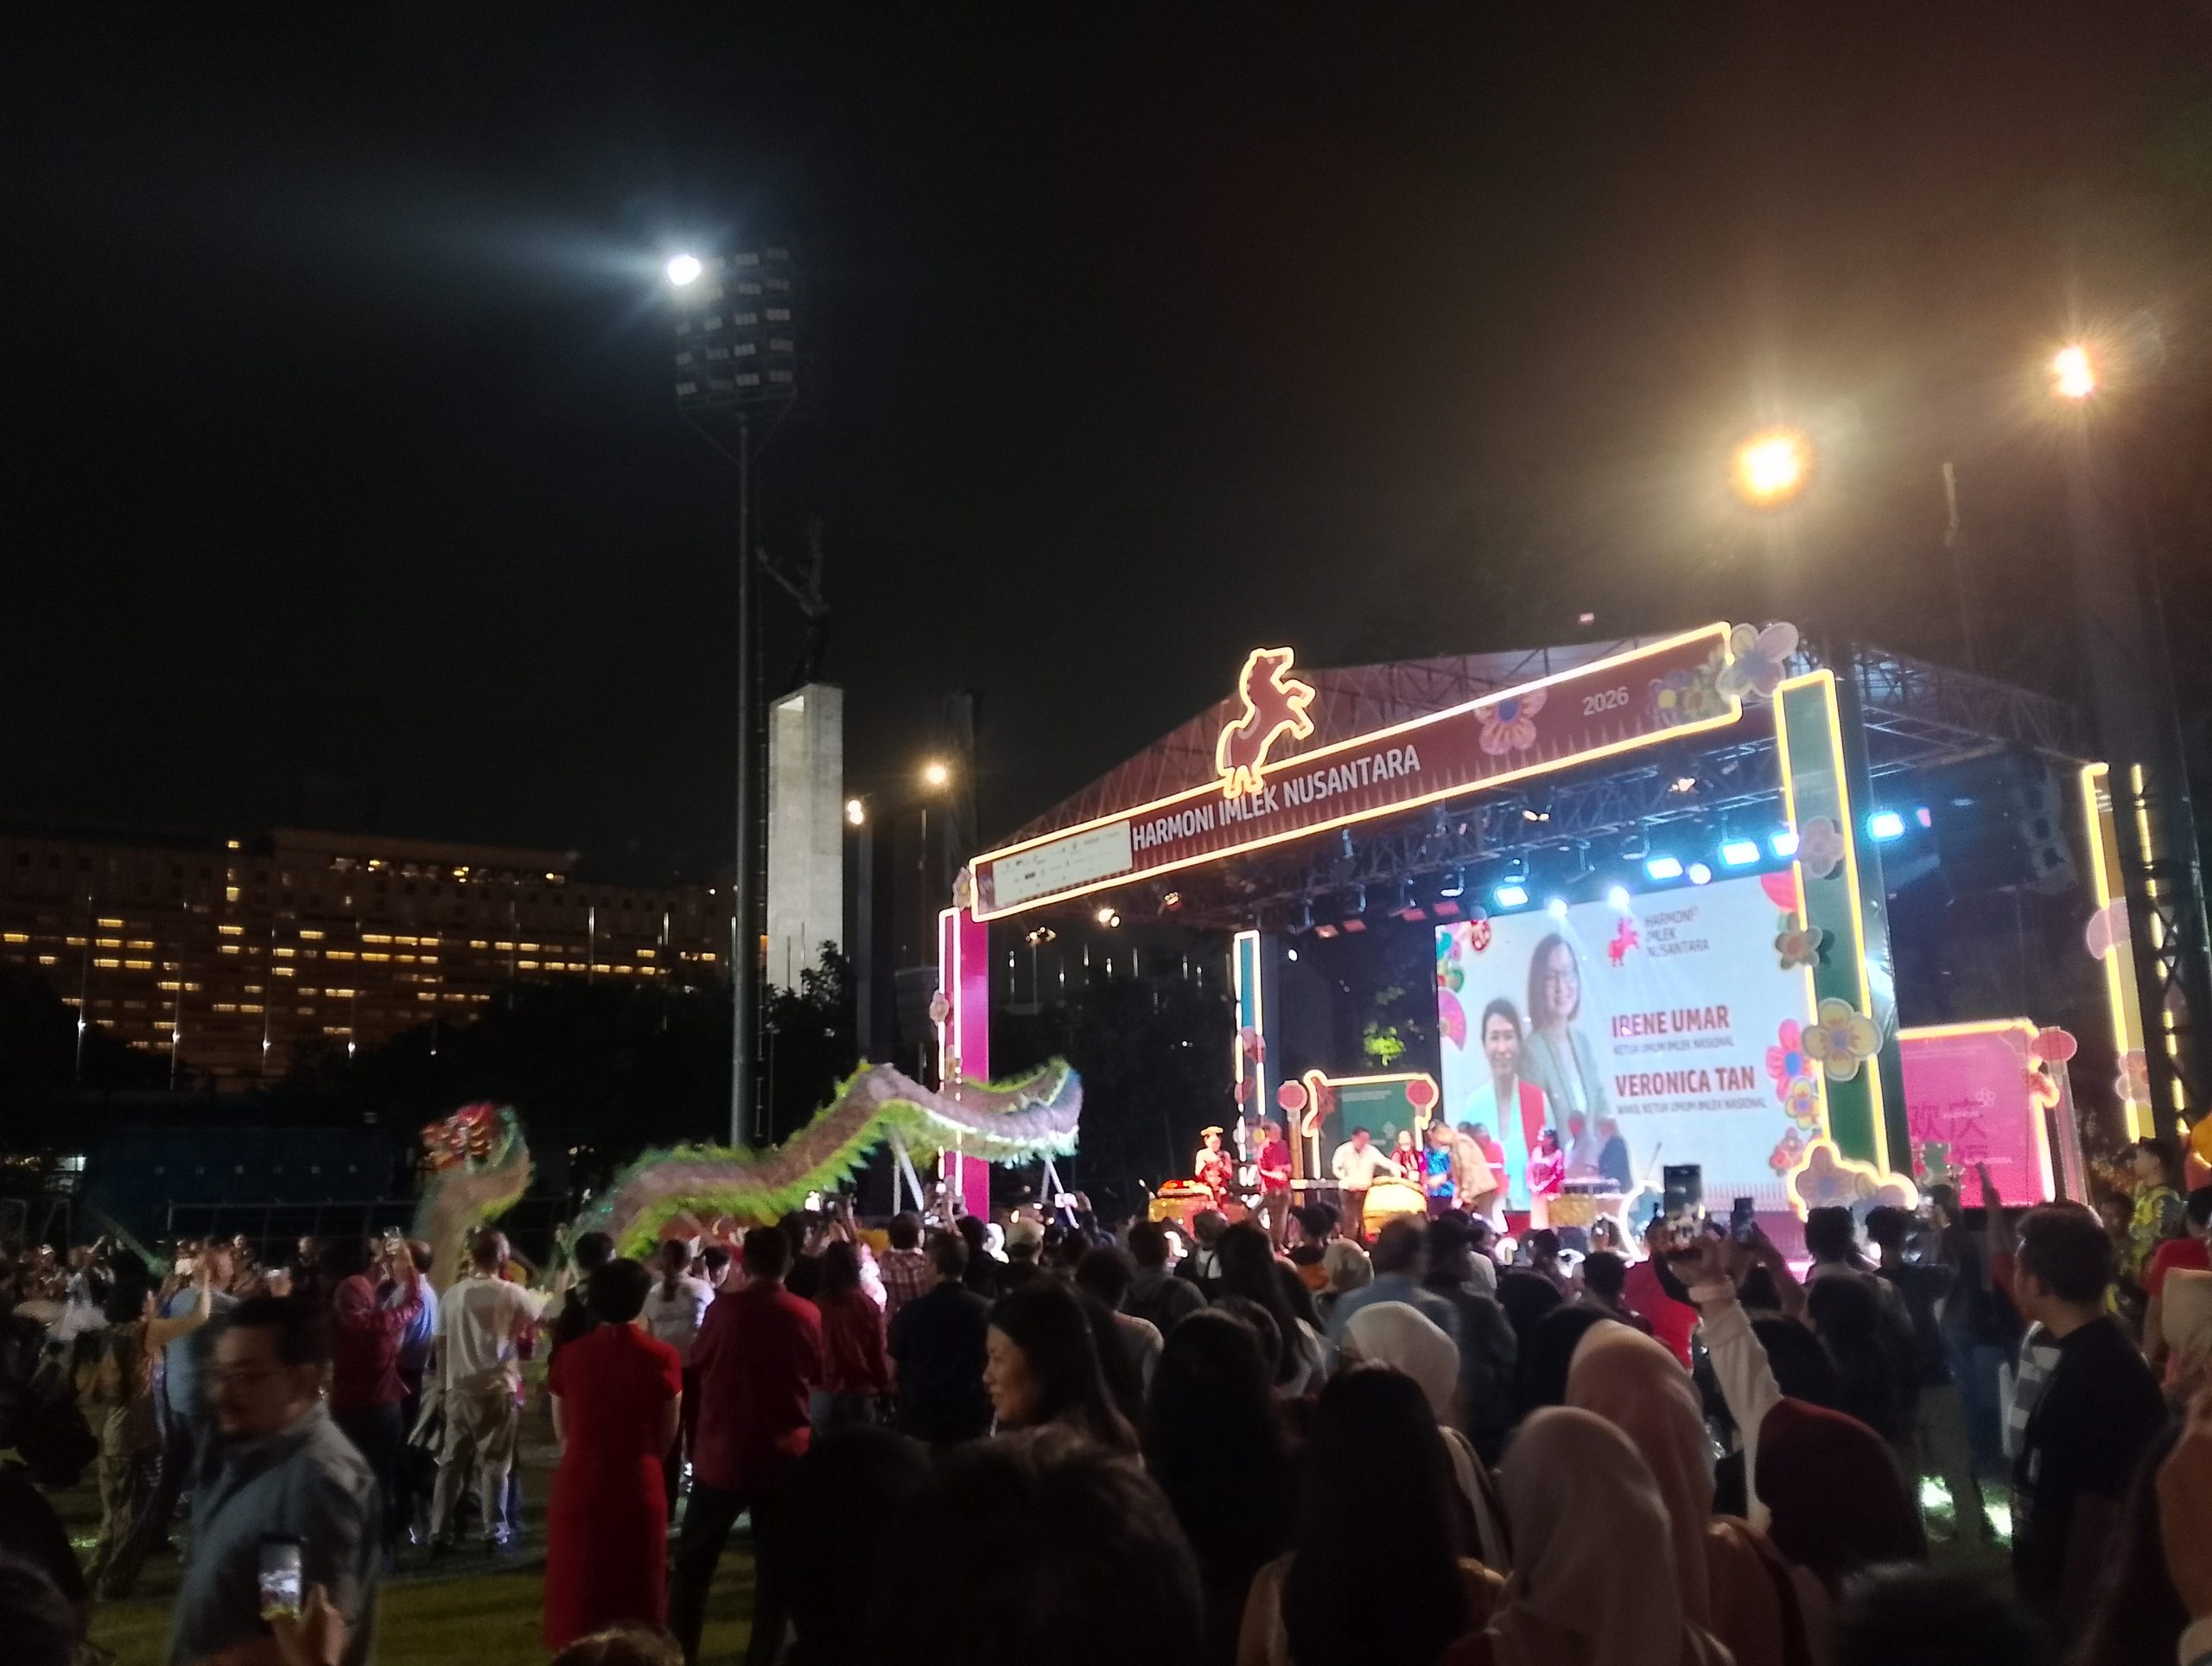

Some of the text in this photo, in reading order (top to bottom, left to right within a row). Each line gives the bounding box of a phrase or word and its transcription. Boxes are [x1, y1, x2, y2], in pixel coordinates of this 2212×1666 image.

[1582, 686, 1629, 715] 2026
[1133, 744, 1421, 850] HARMONI IMLEK NUSANTARA
[1611, 1005, 1730, 1037] IRENE UMAR
[1615, 1065, 1755, 1097] VERONICA TAN
